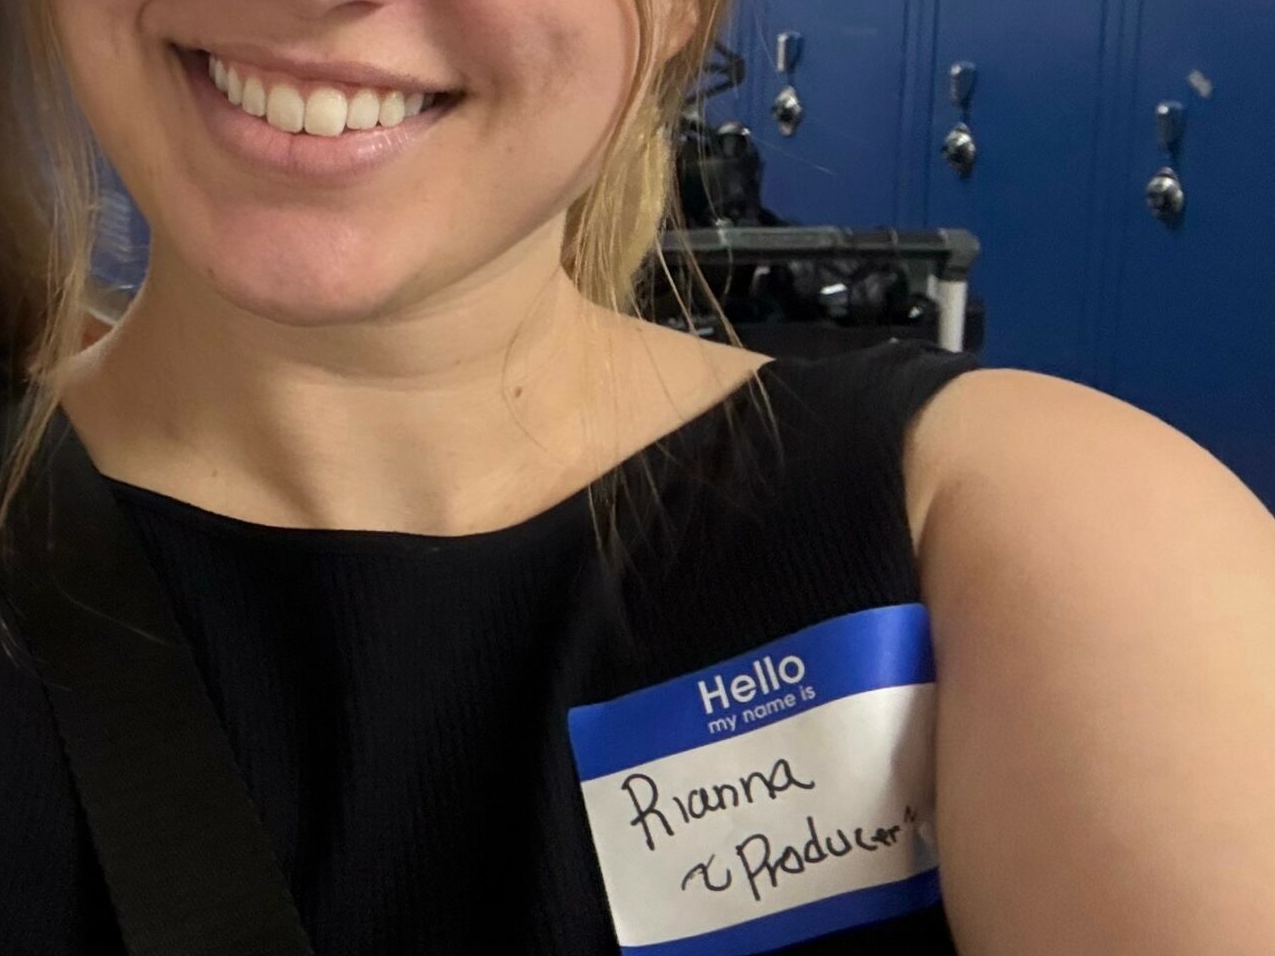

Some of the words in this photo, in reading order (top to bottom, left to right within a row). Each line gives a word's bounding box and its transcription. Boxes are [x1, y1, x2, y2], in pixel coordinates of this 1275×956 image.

[697, 655, 806, 715] Hello
[708, 714, 738, 735] my
[742, 693, 797, 724] name
[799, 685, 817, 702] is
[621, 758, 816, 851] Rianna
